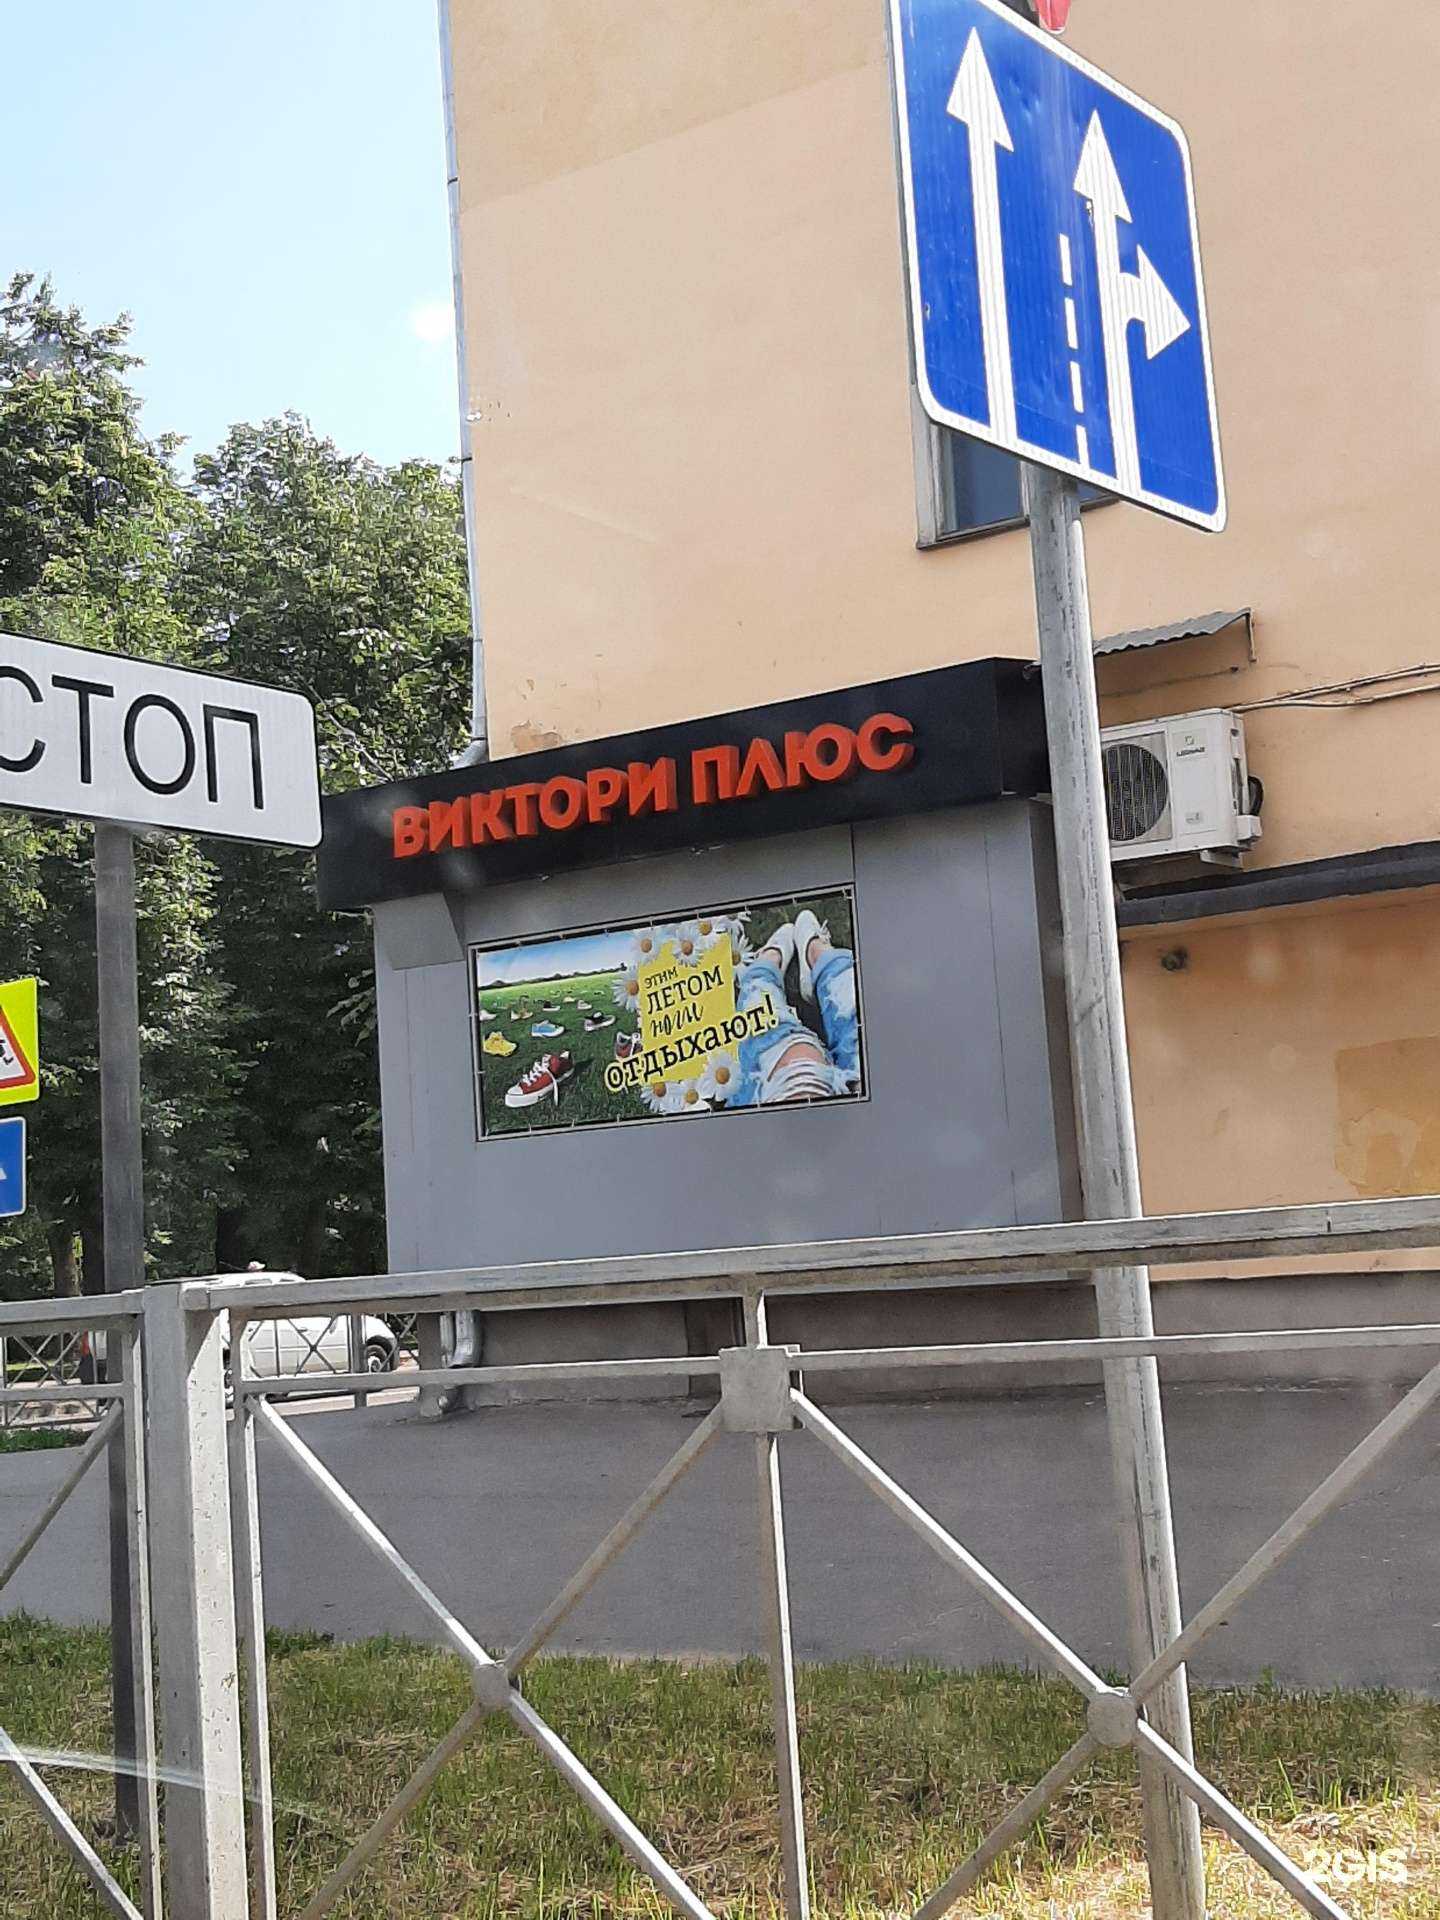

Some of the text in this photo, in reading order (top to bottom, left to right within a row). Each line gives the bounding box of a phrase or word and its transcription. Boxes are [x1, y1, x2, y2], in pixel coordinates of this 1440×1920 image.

[392, 712, 915, 858] ВИКТОРИ ПЛЮС
[647, 965, 724, 1015] ЛЕТОМ
